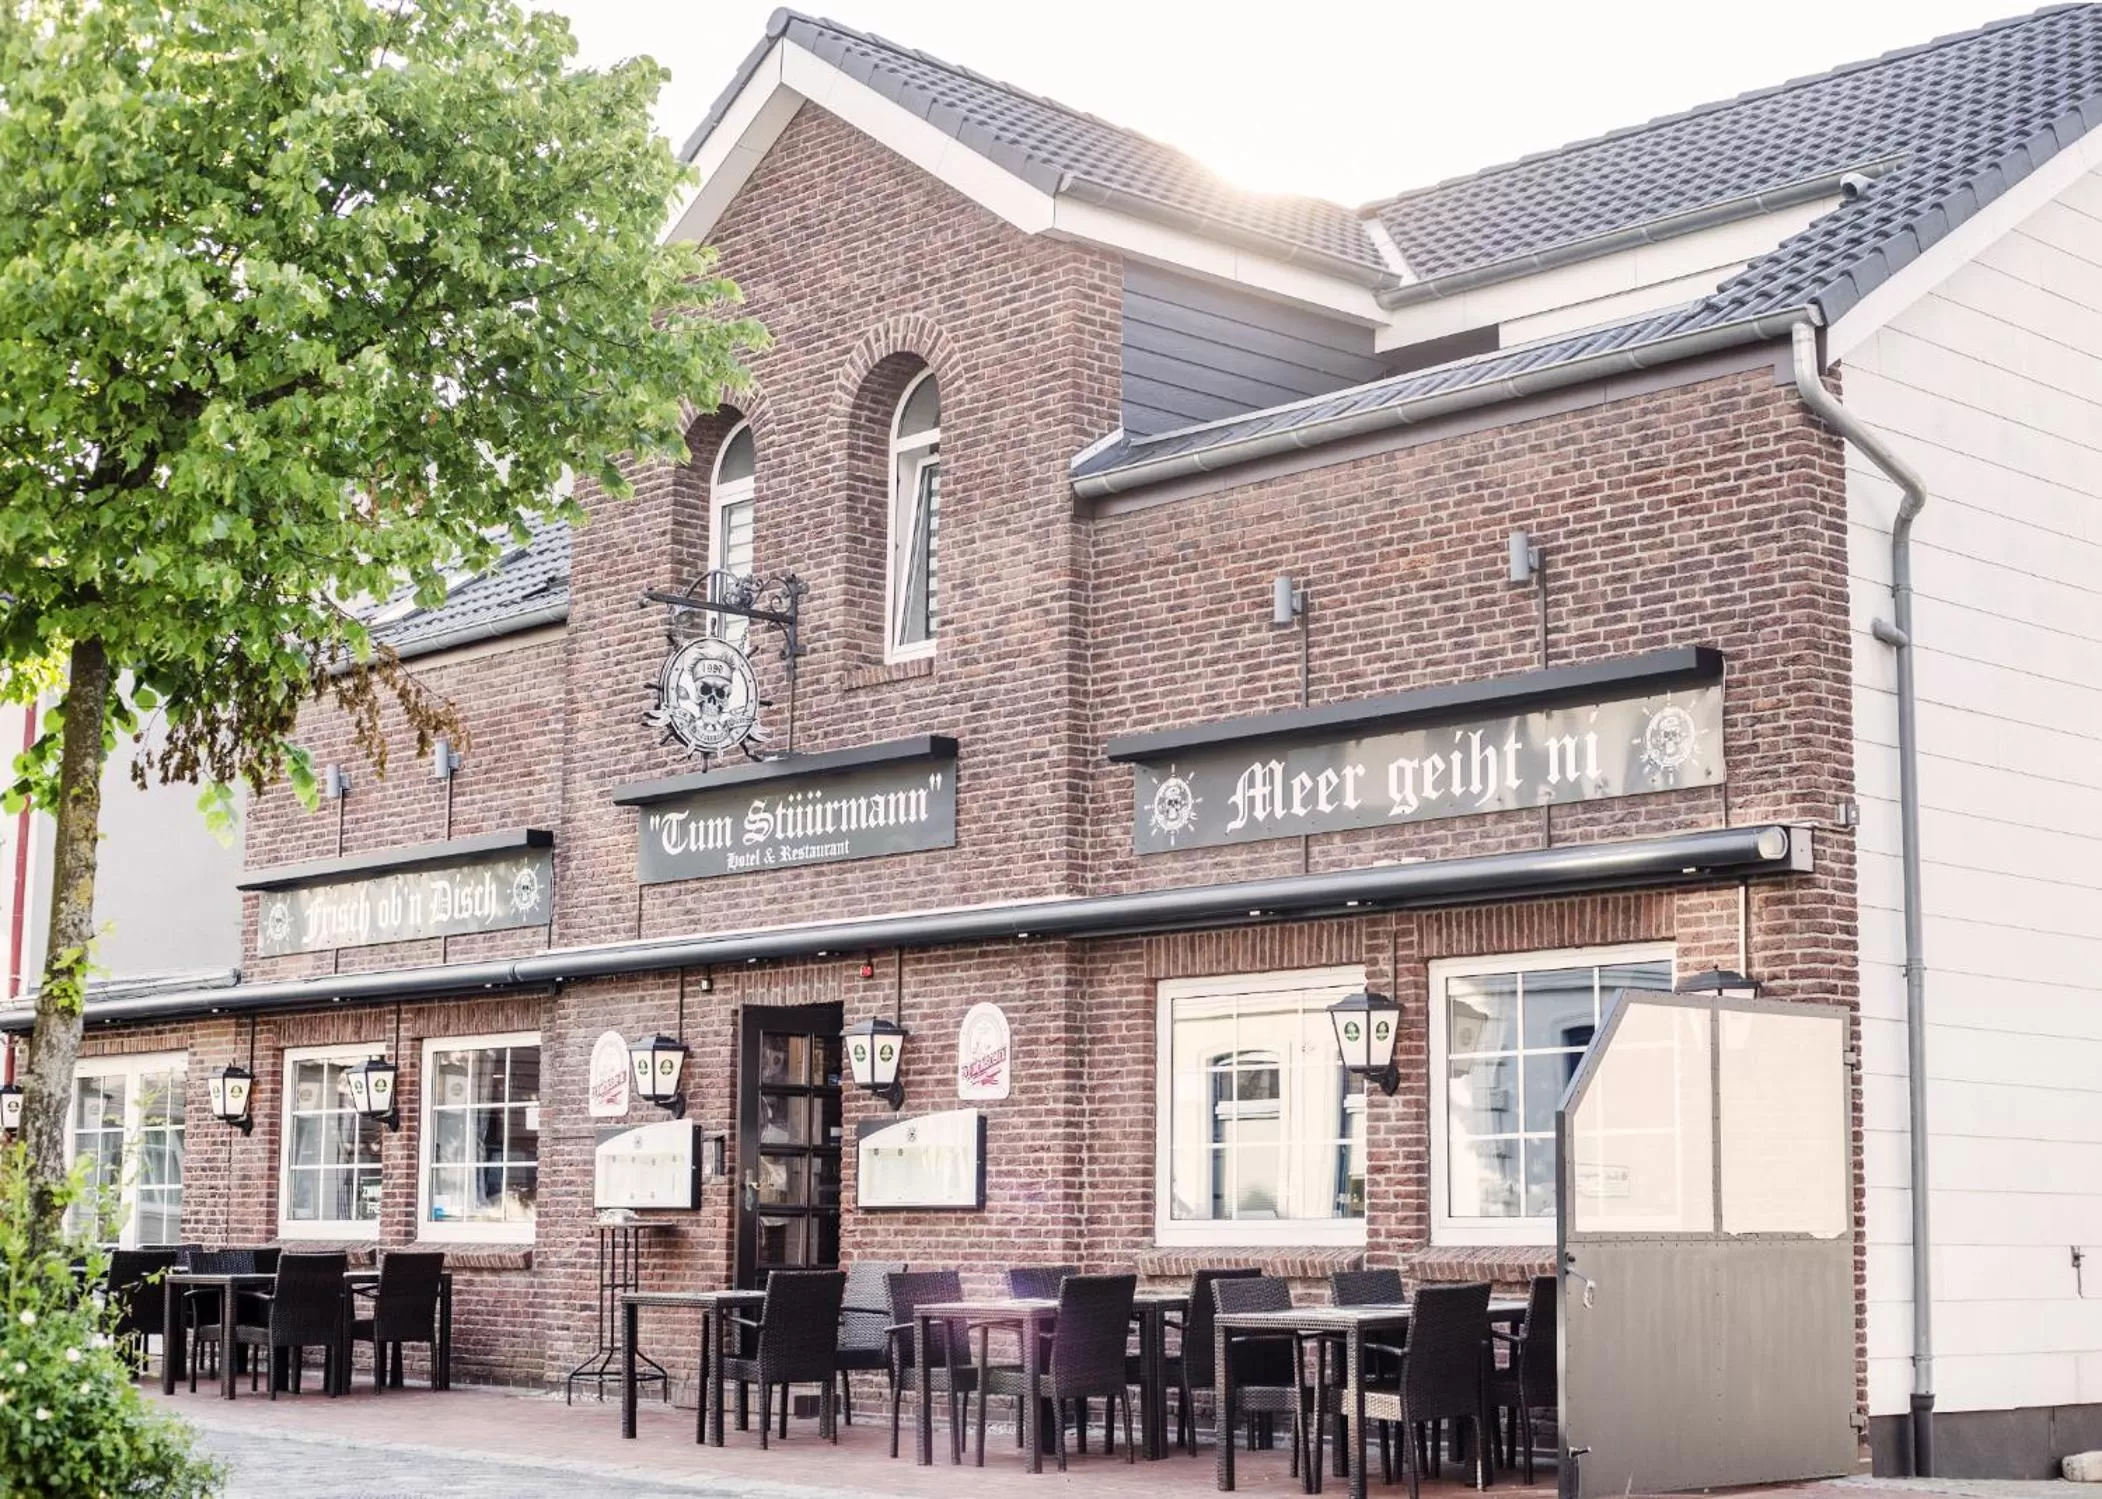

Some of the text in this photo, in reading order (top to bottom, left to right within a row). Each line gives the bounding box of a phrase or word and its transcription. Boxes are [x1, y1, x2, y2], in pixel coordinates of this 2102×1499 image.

[1225, 709, 1603, 833] Meer geiht ni
[650, 772, 943, 855] "Tum Stüürmann"
[727, 840, 850, 872] Hotel & Restaurant
[429, 871, 497, 925] Disch
